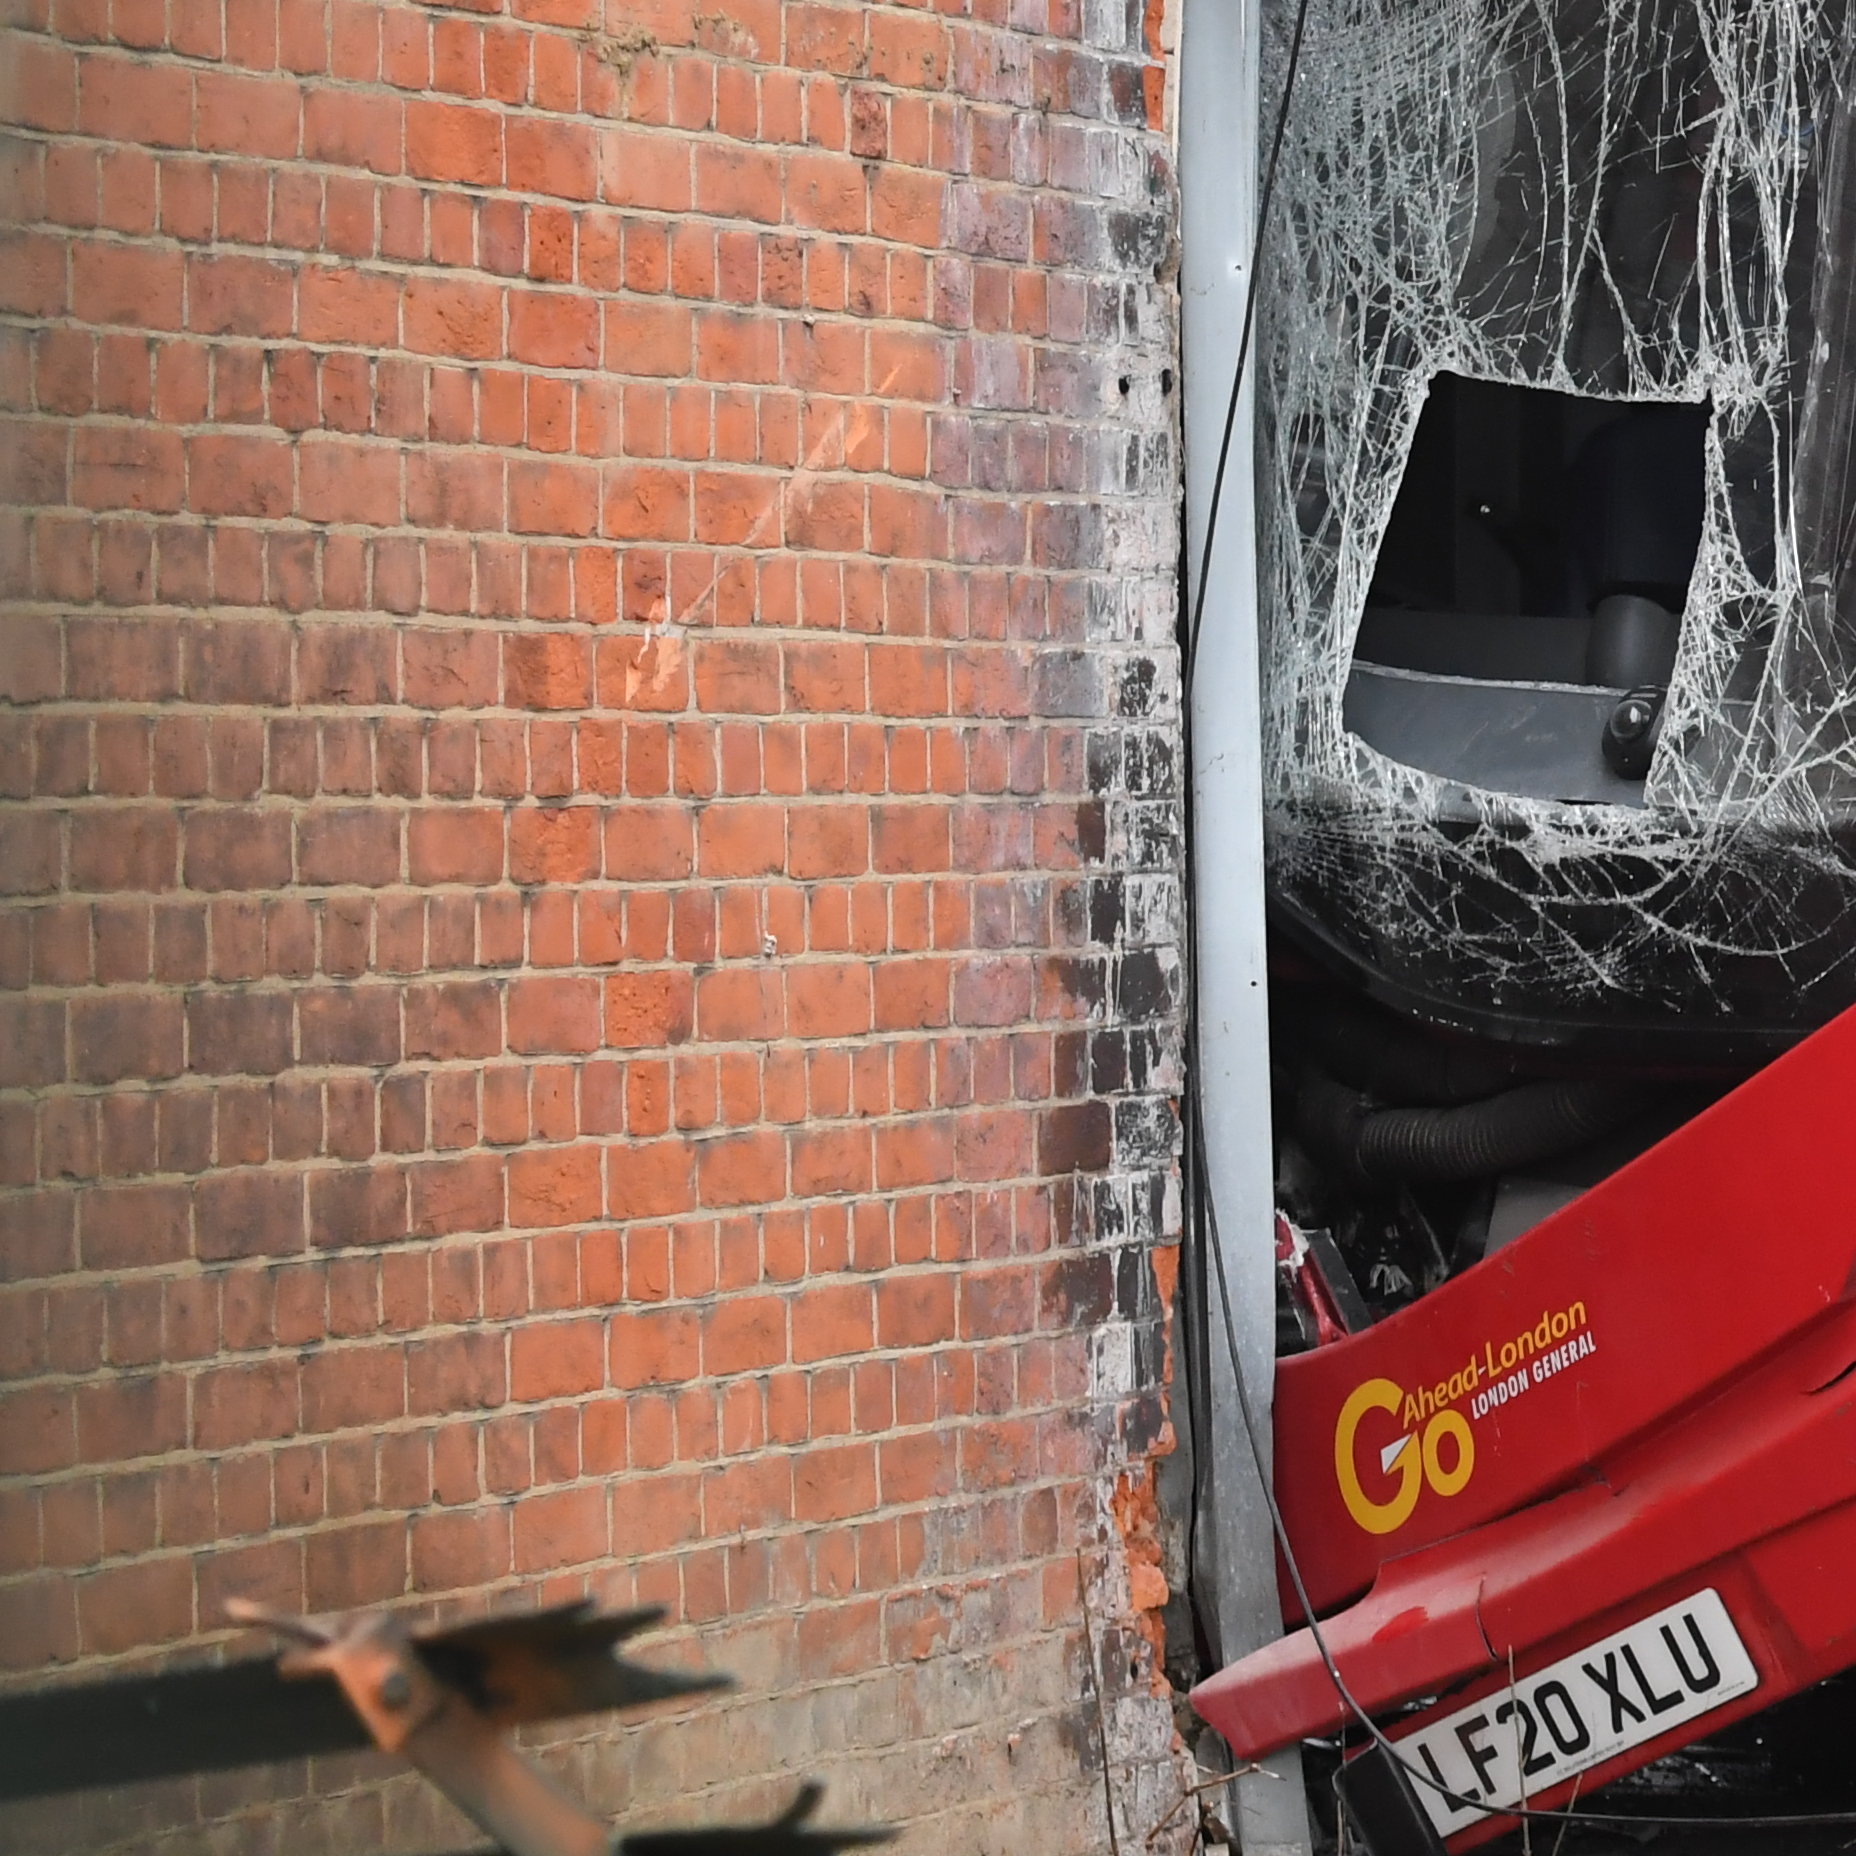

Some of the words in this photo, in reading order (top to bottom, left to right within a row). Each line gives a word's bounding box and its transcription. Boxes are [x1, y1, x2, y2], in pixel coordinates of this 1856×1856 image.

[1403, 1300, 1588, 1429] Ahead-London
[1470, 1372, 1531, 1420] LONDON
[1532, 1329, 1598, 1386] GENERAL
[1334, 1377, 1475, 1535] Go
[1418, 1679, 1592, 1814] LF20
[1582, 1612, 1723, 1736] XLU
